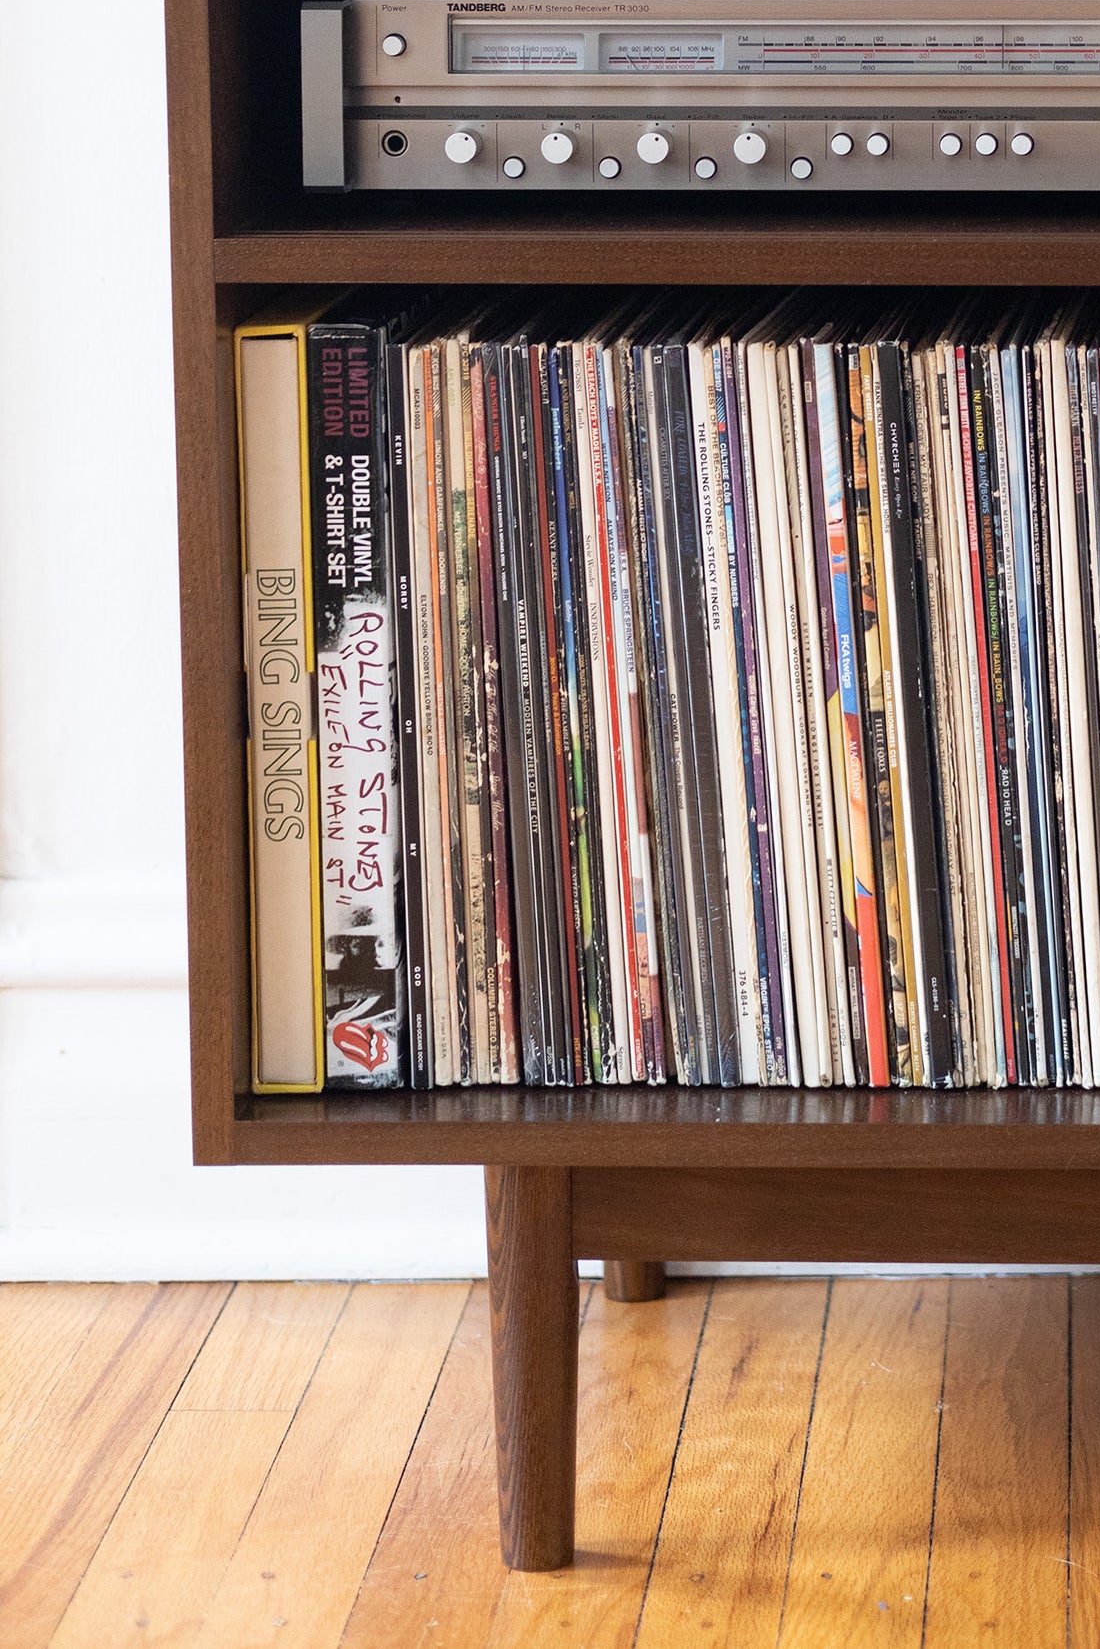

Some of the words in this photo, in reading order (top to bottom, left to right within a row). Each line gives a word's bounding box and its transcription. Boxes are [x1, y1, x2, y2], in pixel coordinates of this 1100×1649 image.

[447, 3, 506, 12] TANDBERG
[322, 347, 345, 437] EDITION
[346, 347, 370, 437] LIMITED
[489, 376, 498, 420] STRANGER
[863, 375, 871, 393] FAYE
[413, 388, 422, 429] MCA2-10003
[864, 395, 873, 421] WEBSTER
[491, 423, 500, 452] THINGS
[697, 422, 706, 443] THE
[974, 405, 985, 450] RAINBOWS
[324, 455, 341, 469] &
[434, 440, 443, 464] SIMON
[719, 443, 729, 479] CULTURE
[978, 454, 987, 463] IN
[435, 467, 443, 484] AND
[699, 446, 709, 491] ROLLING
[351, 455, 370, 529] DOUBLE
[325, 473, 345, 547] T-SHIRT
[436, 487, 445, 532] GARFUNKEL
[983, 516, 992, 525] IN
[352, 533, 372, 587] VINYL
[584, 535, 594, 558] Stevie
[728, 555, 736, 565] BY
[327, 552, 346, 587] SET
[438, 552, 446, 595] BOOKENDS
[586, 561, 596, 588] Wonder
[988, 579, 996, 587] IN
[729, 568, 738, 607] NUMBERS
[420, 594, 428, 616] ELTON
[711, 587, 721, 630] FINGERS
[256, 569, 300, 685] BING
[421, 618, 429, 638] JOHN
[517, 599, 526, 644] VAMPIRE
[590, 602, 599, 661] INNERVISIONS
[840, 635, 850, 656] FKA
[992, 642, 1000, 651] IN
[422, 645, 431, 679] GOODBYE
[520, 648, 529, 687] WEEKEND
[840, 658, 853, 688] twigs
[424, 681, 432, 711] YELLOW
[883, 671, 892, 699] ATLANTA
[394, 435, 403, 466] KEVIN
[399, 576, 409, 610] MORBY
[405, 720, 413, 734] OH
[409, 843, 417, 857] MY
[413, 966, 422, 987] GOD
[523, 699, 531, 735] MODERN
[670, 694, 678, 710] CAT
[671, 713, 680, 742] POWER
[886, 701, 896, 749] MILLIONAIRES
[327, 742, 346, 768] ON
[525, 738, 534, 779] VAMPIRES
[889, 750, 897, 767] CLUB
[260, 702, 305, 842] SINGS
[849, 741, 862, 800] MAGDALENE
[528, 782, 535, 793] OF
[324, 784, 348, 841] MAIN
[530, 815, 538, 833] CITY
[738, 971, 747, 986] 376
[740, 990, 749, 1016] 484-4
